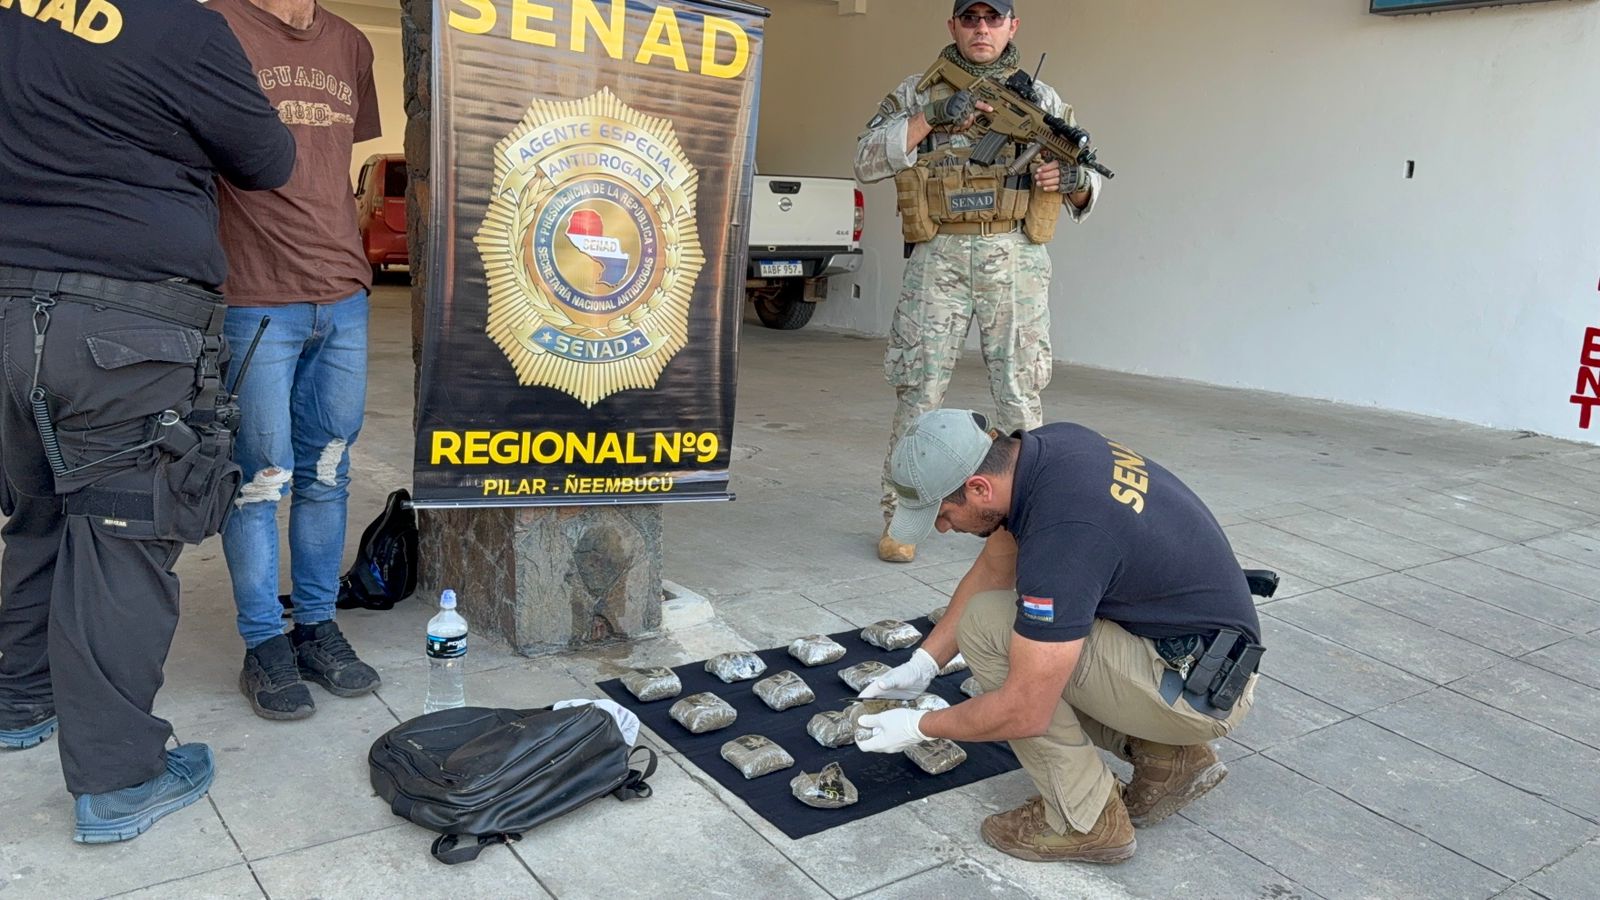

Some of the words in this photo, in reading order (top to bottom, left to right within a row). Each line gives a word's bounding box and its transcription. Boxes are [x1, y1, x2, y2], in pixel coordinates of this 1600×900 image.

[448, 0, 749, 79] SENAD
[519, 123, 591, 163] AGENTE
[600, 123, 678, 180] ESPECIAL
[548, 152, 654, 189] ANTIDROGAS
[541, 183, 591, 236] PRESIDENCIA
[593, 183, 605, 194] DE
[607, 185, 619, 199] LA
[620, 193, 653, 245] REPÚBLICA
[951, 195, 993, 209] SENAD
[582, 238, 618, 252] SENAD
[538, 246, 573, 302] SECRETARÍA
[571, 295, 617, 311] NACIONAL
[618, 257, 654, 307] ANTIDROGAS
[554, 334, 628, 358] SENAD
[430, 431, 647, 465] REGIONAL
[483, 478, 546, 496] PILAR
[564, 473, 674, 494] ÑEEMBUCÚ
